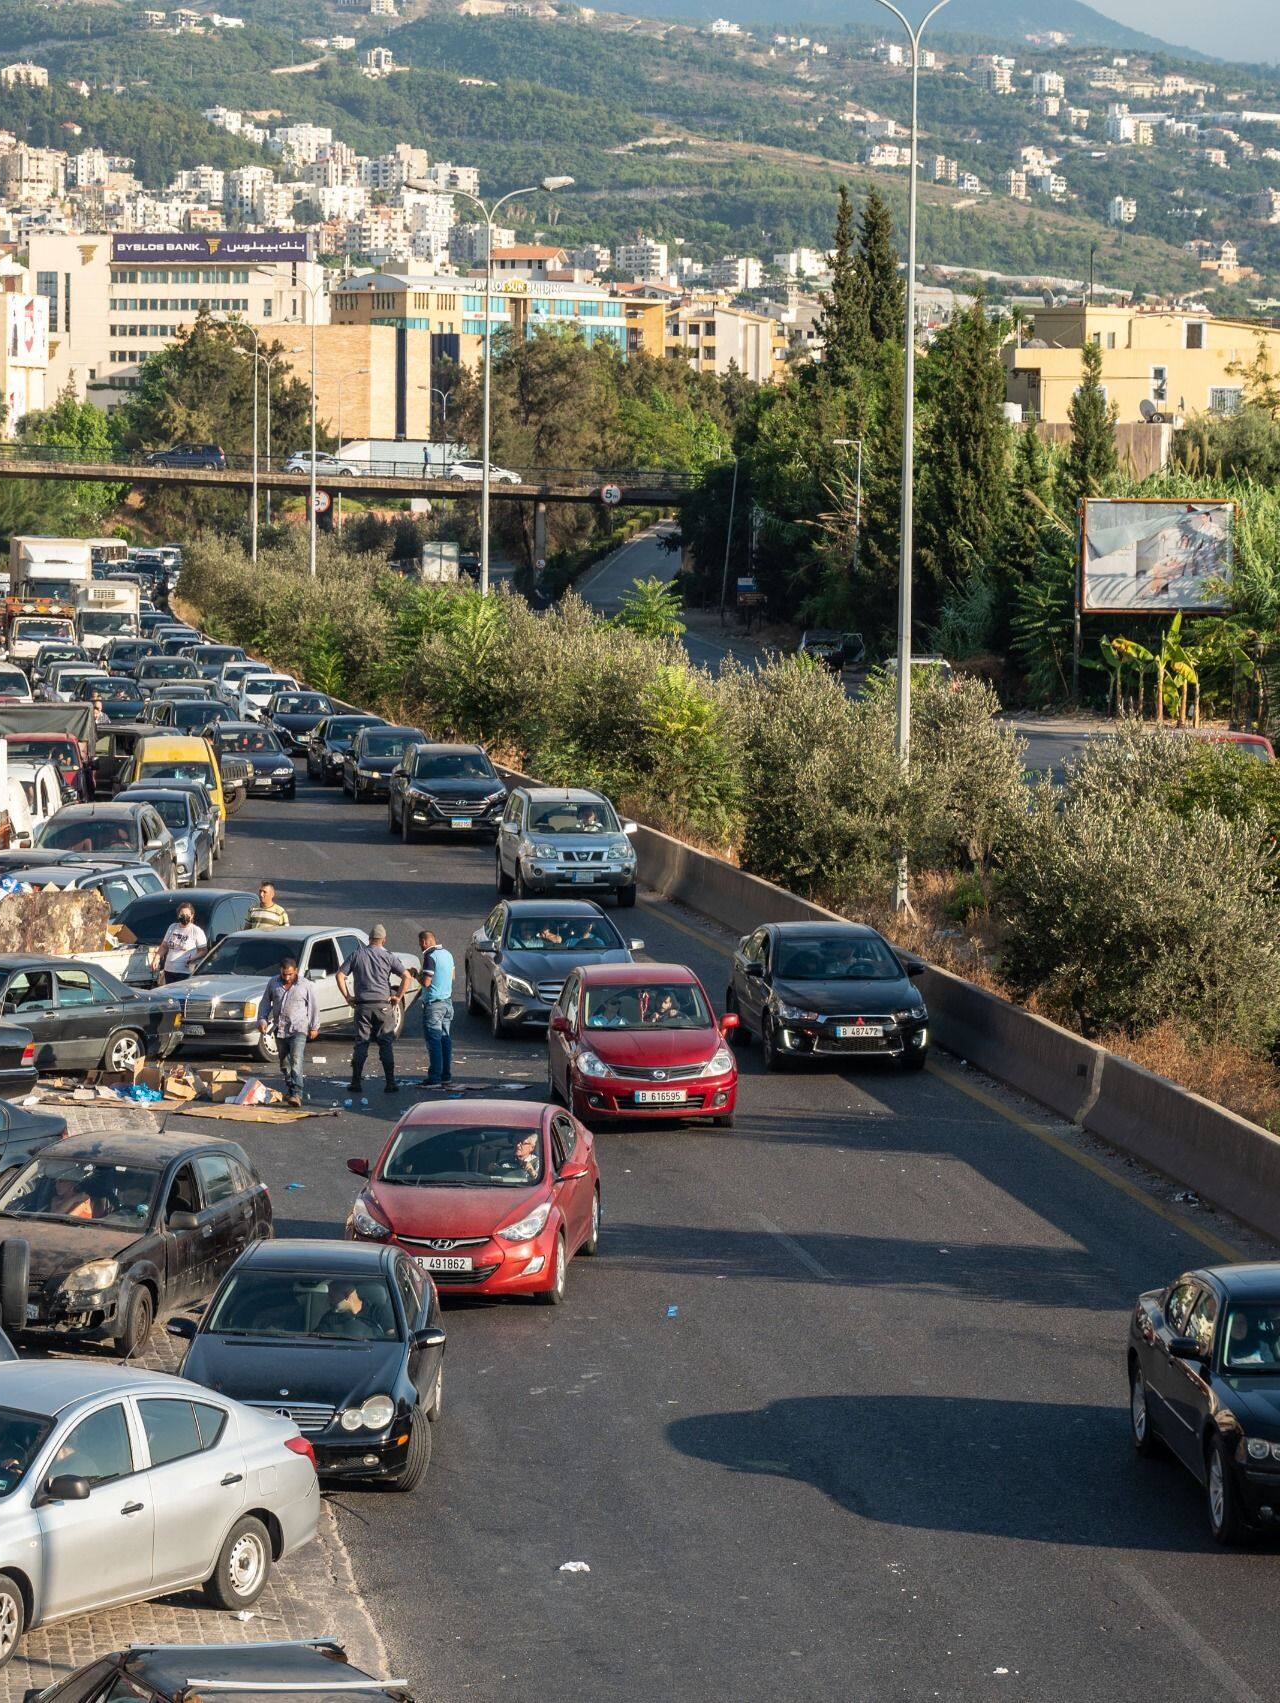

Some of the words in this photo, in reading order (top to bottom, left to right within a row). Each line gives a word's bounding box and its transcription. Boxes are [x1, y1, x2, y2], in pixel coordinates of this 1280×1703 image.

[166, 243, 200, 251] BANK
[605, 489, 612, 498] 5
[851, 1028, 878, 1036] 487472
[641, 1091, 646, 1100] B
[651, 1090, 681, 1100] 616595
[417, 1258, 424, 1268] B
[429, 1258, 466, 1270] 491862
